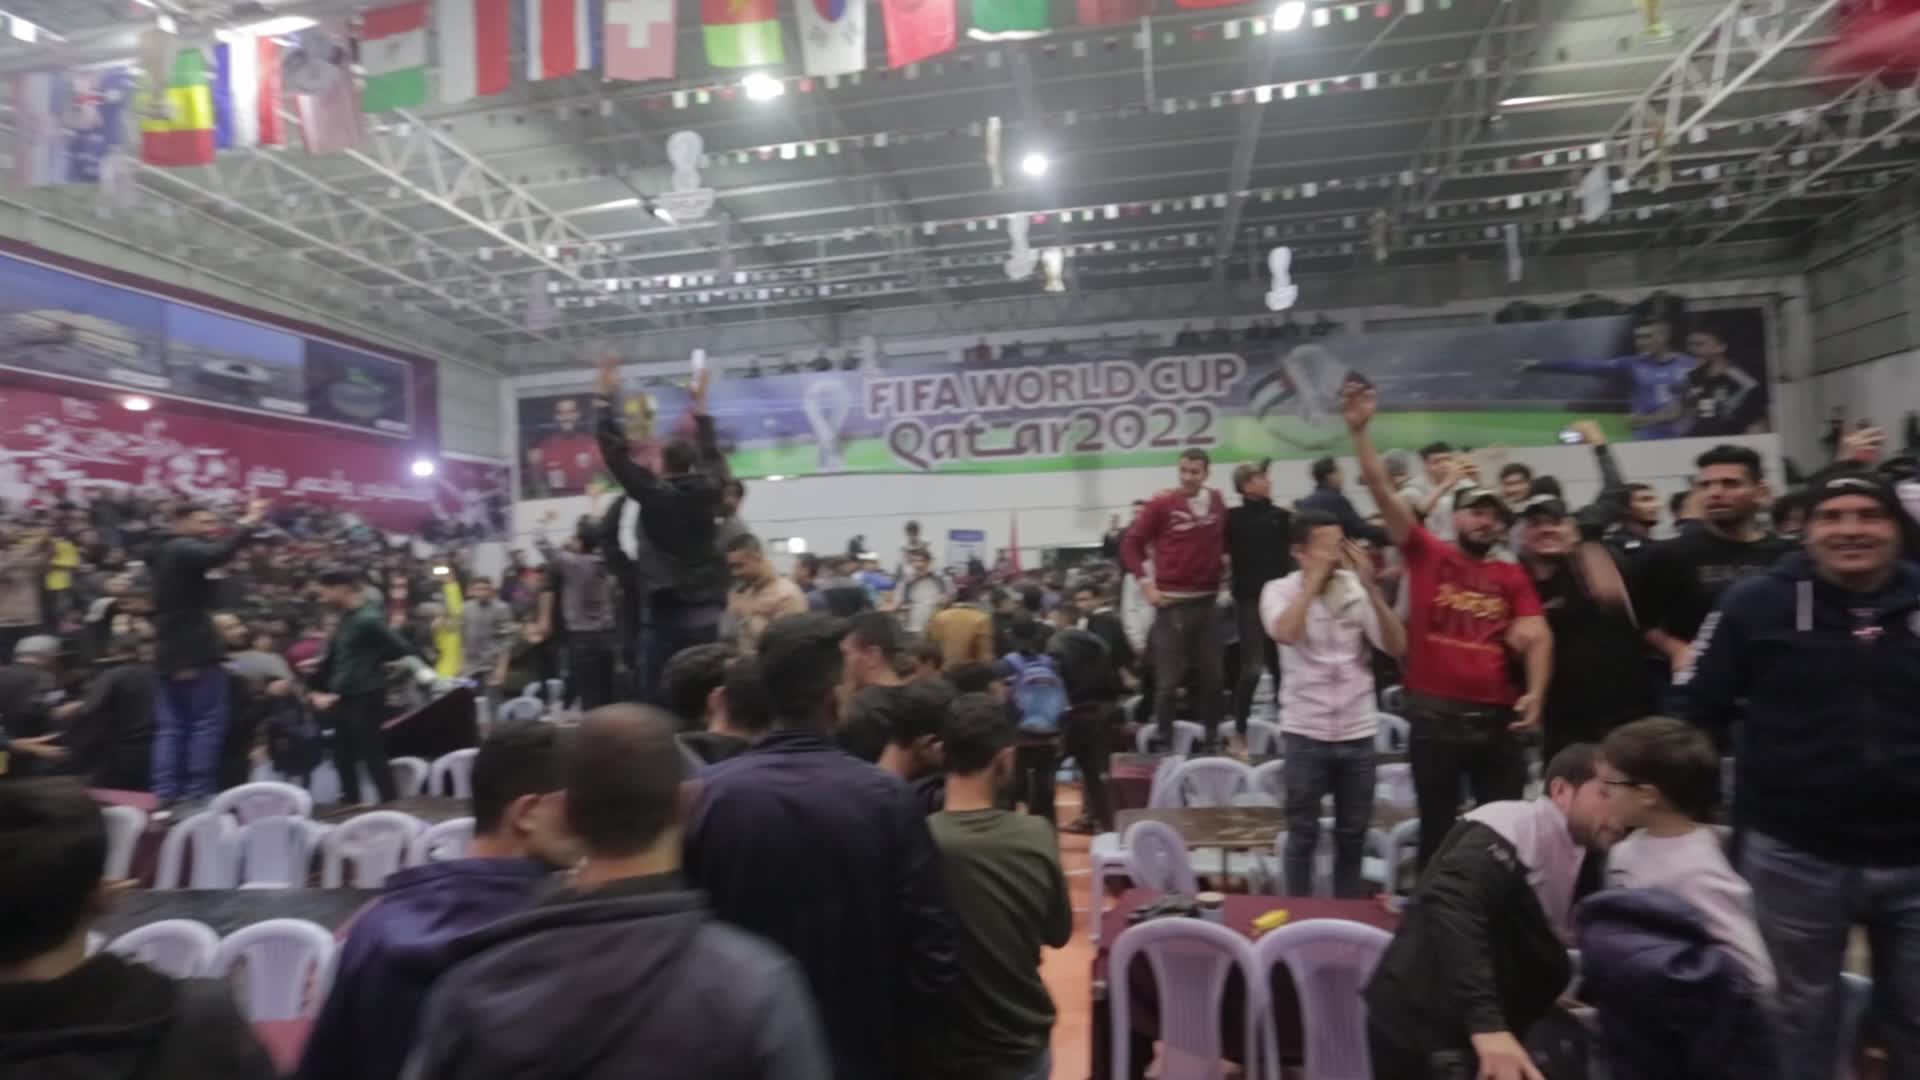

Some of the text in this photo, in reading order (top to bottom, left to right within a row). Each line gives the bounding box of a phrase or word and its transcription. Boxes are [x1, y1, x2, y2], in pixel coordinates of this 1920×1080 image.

[870, 358, 1239, 416] FIFA WORLD CUP
